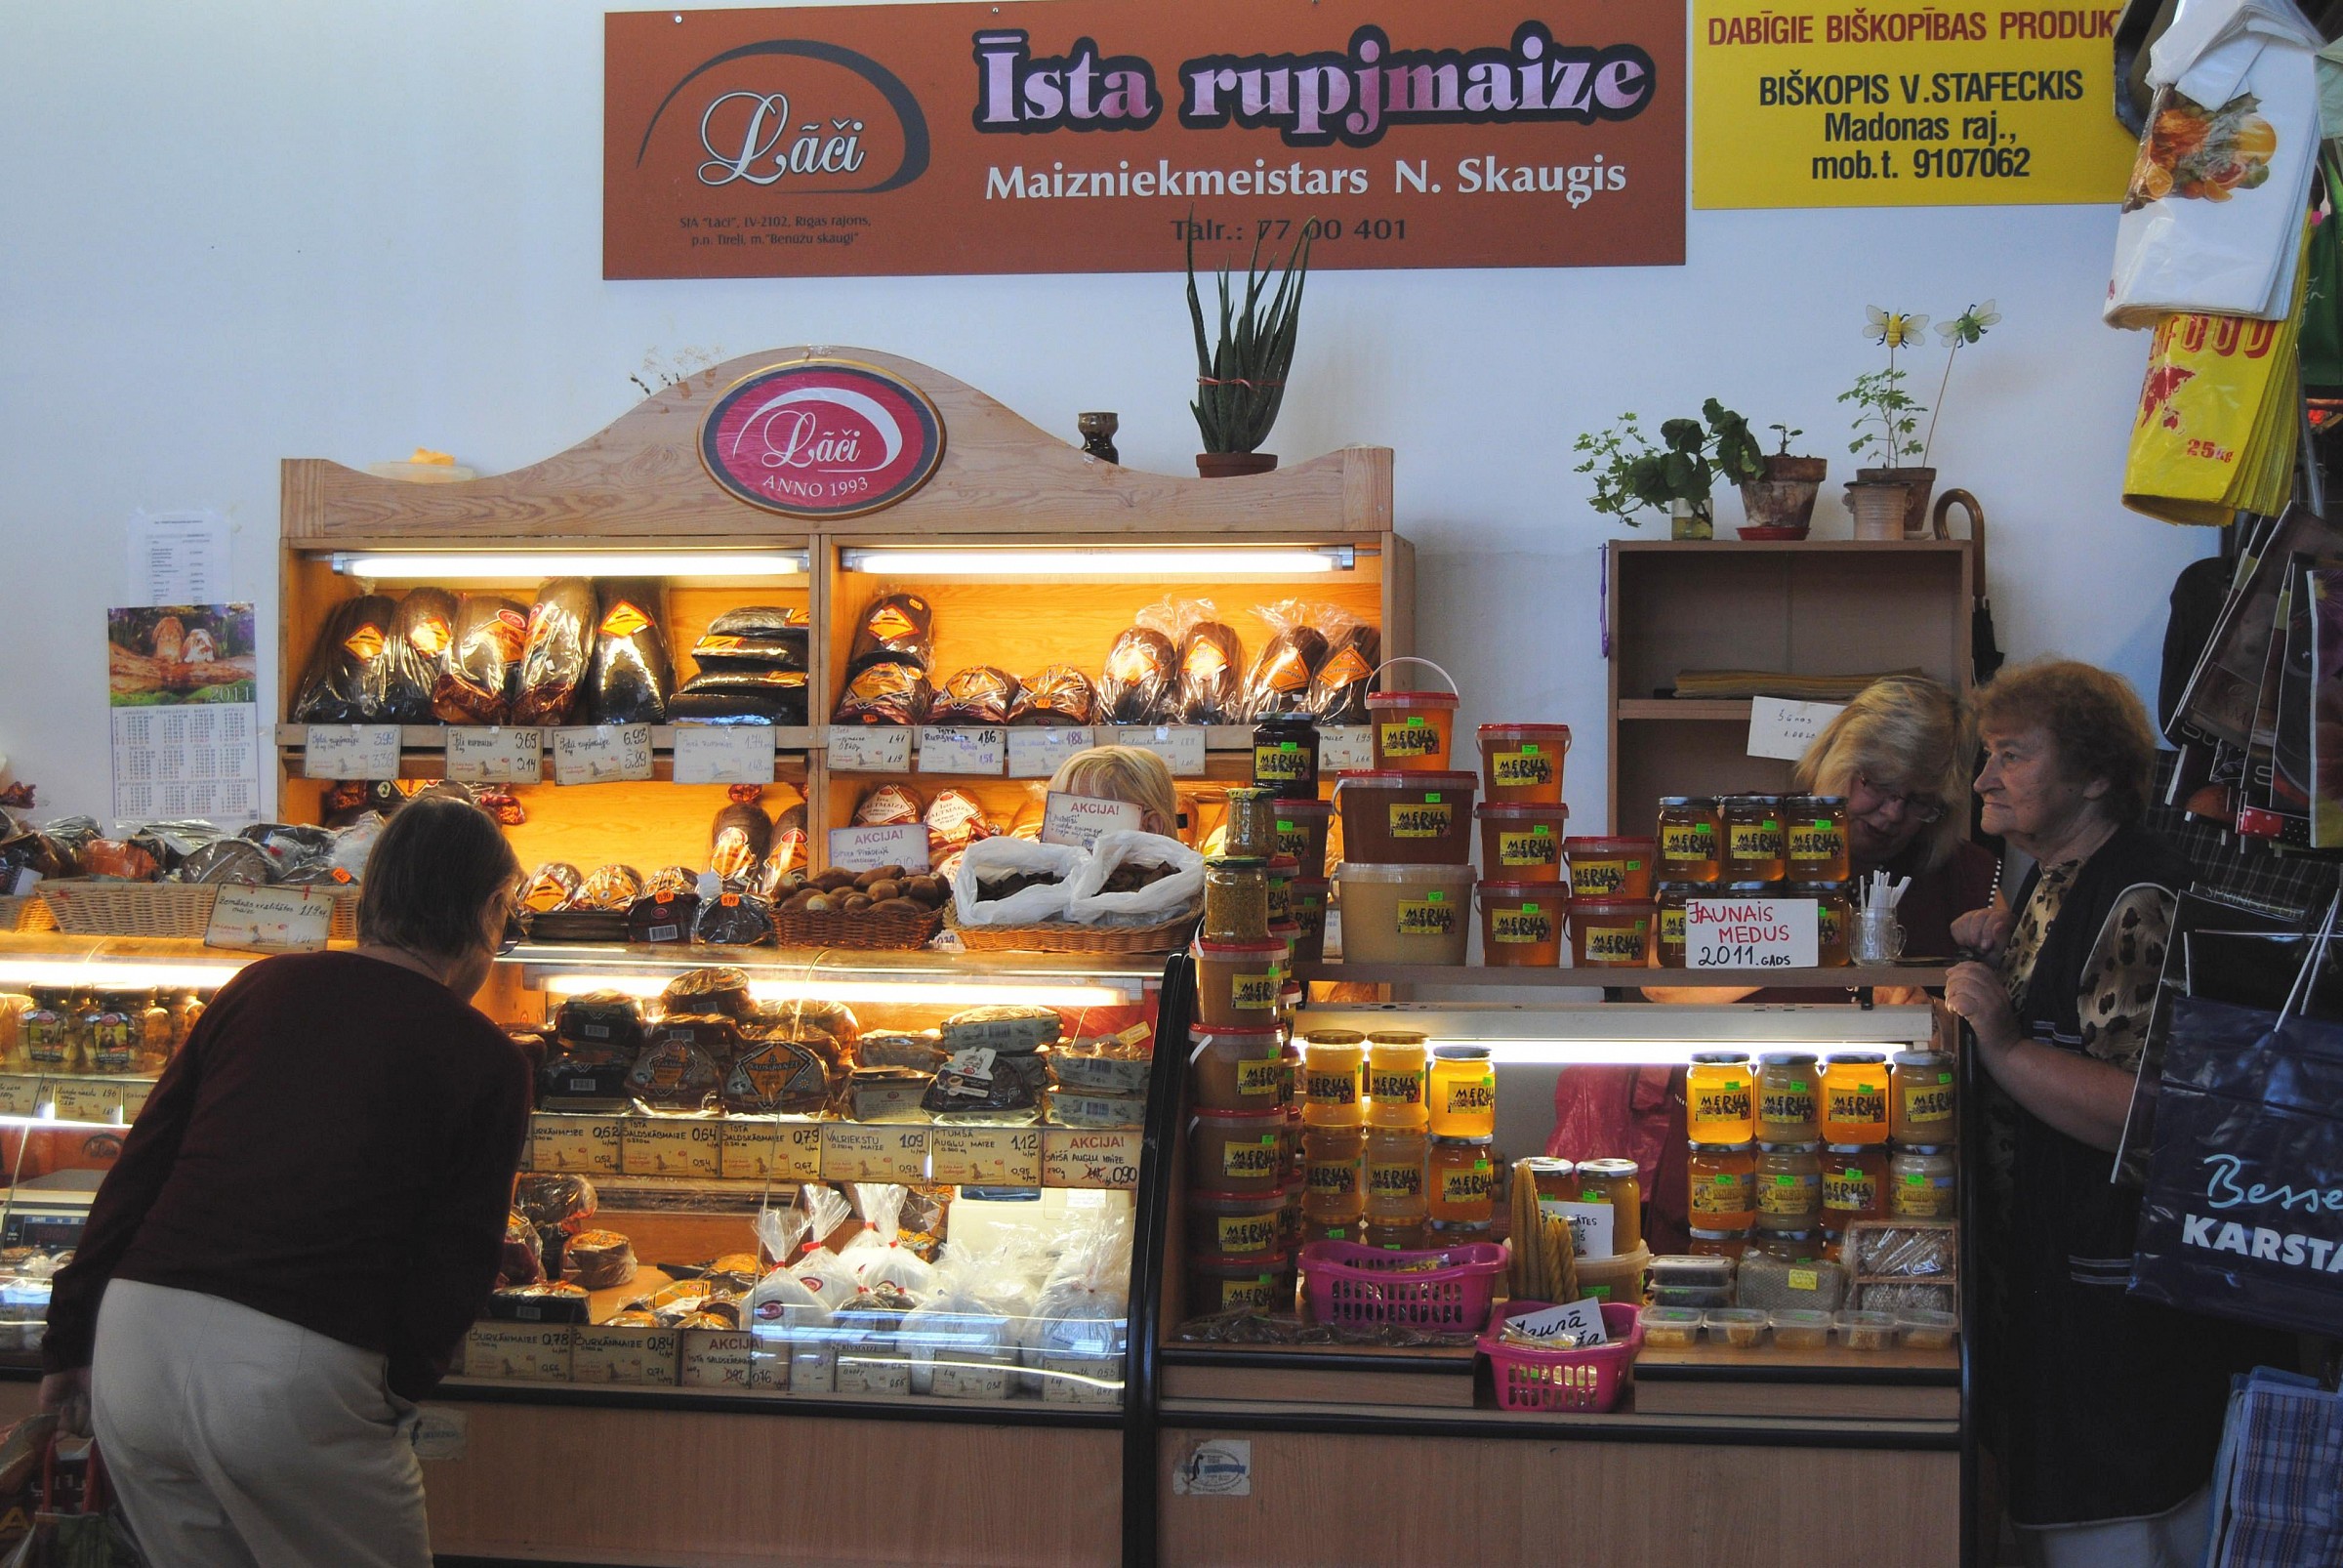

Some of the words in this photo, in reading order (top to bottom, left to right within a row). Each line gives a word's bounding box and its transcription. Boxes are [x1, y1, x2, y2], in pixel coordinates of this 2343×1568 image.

[1707, 10, 1813, 46] DABĪGIE
[1827, 6, 1987, 43] BIŠKOPĪBAS
[977, 34, 1156, 126] Īsta
[1186, 34, 1648, 137] rupjmaize
[1759, 70, 1890, 106] BIŠKOPIS
[1825, 111, 1950, 143] Madonas
[1961, 114, 2017, 148] raj.,
[698, 91, 865, 187] Lāči
[1913, 148, 2032, 179] 9107062
[986, 158, 1369, 200] Maizniekmeistars
[1396, 159, 1441, 194] N.
[1458, 154, 1627, 210] Skauģis
[679, 218, 698, 229] SIA
[745, 216, 791, 228] LV-2102,
[832, 216, 872, 228] rajons,
[1257, 219, 1291, 241] 77
[1304, 219, 1341, 241] 00
[1353, 219, 1407, 241] 401
[761, 410, 861, 469] Lāči
[762, 475, 823, 498] ANNO
[830, 476, 868, 497] 1993
[210, 686, 251, 703] 2011
[1387, 729, 1434, 743] MEDUS
[1259, 752, 1304, 765] MEDUS
[1500, 758, 1545, 771] MEDUS
[1070, 802, 1120, 816] AKCIJA!
[1398, 810, 1445, 824] MEDUS
[854, 828, 904, 846] AKCIJA!
[1507, 838, 1552, 850] MEDUS
[1668, 834, 1715, 845] MEDUS
[1738, 833, 1782, 845] MEDUS
[1793, 833, 1838, 845] MEDUS
[1575, 867, 1617, 879] MEDUS
[1406, 907, 1451, 920] MEDUS
[1686, 901, 1774, 924] JAUNAIS
[1499, 915, 1545, 928] MEDUS
[1593, 934, 1640, 946] MEDUS
[1718, 925, 1790, 944] MEDUS
[1701, 1093, 1747, 1106] MEDUS
[1834, 1094, 1882, 1106] MEDUS
[1070, 1135, 1125, 1148] AKCIJA!
